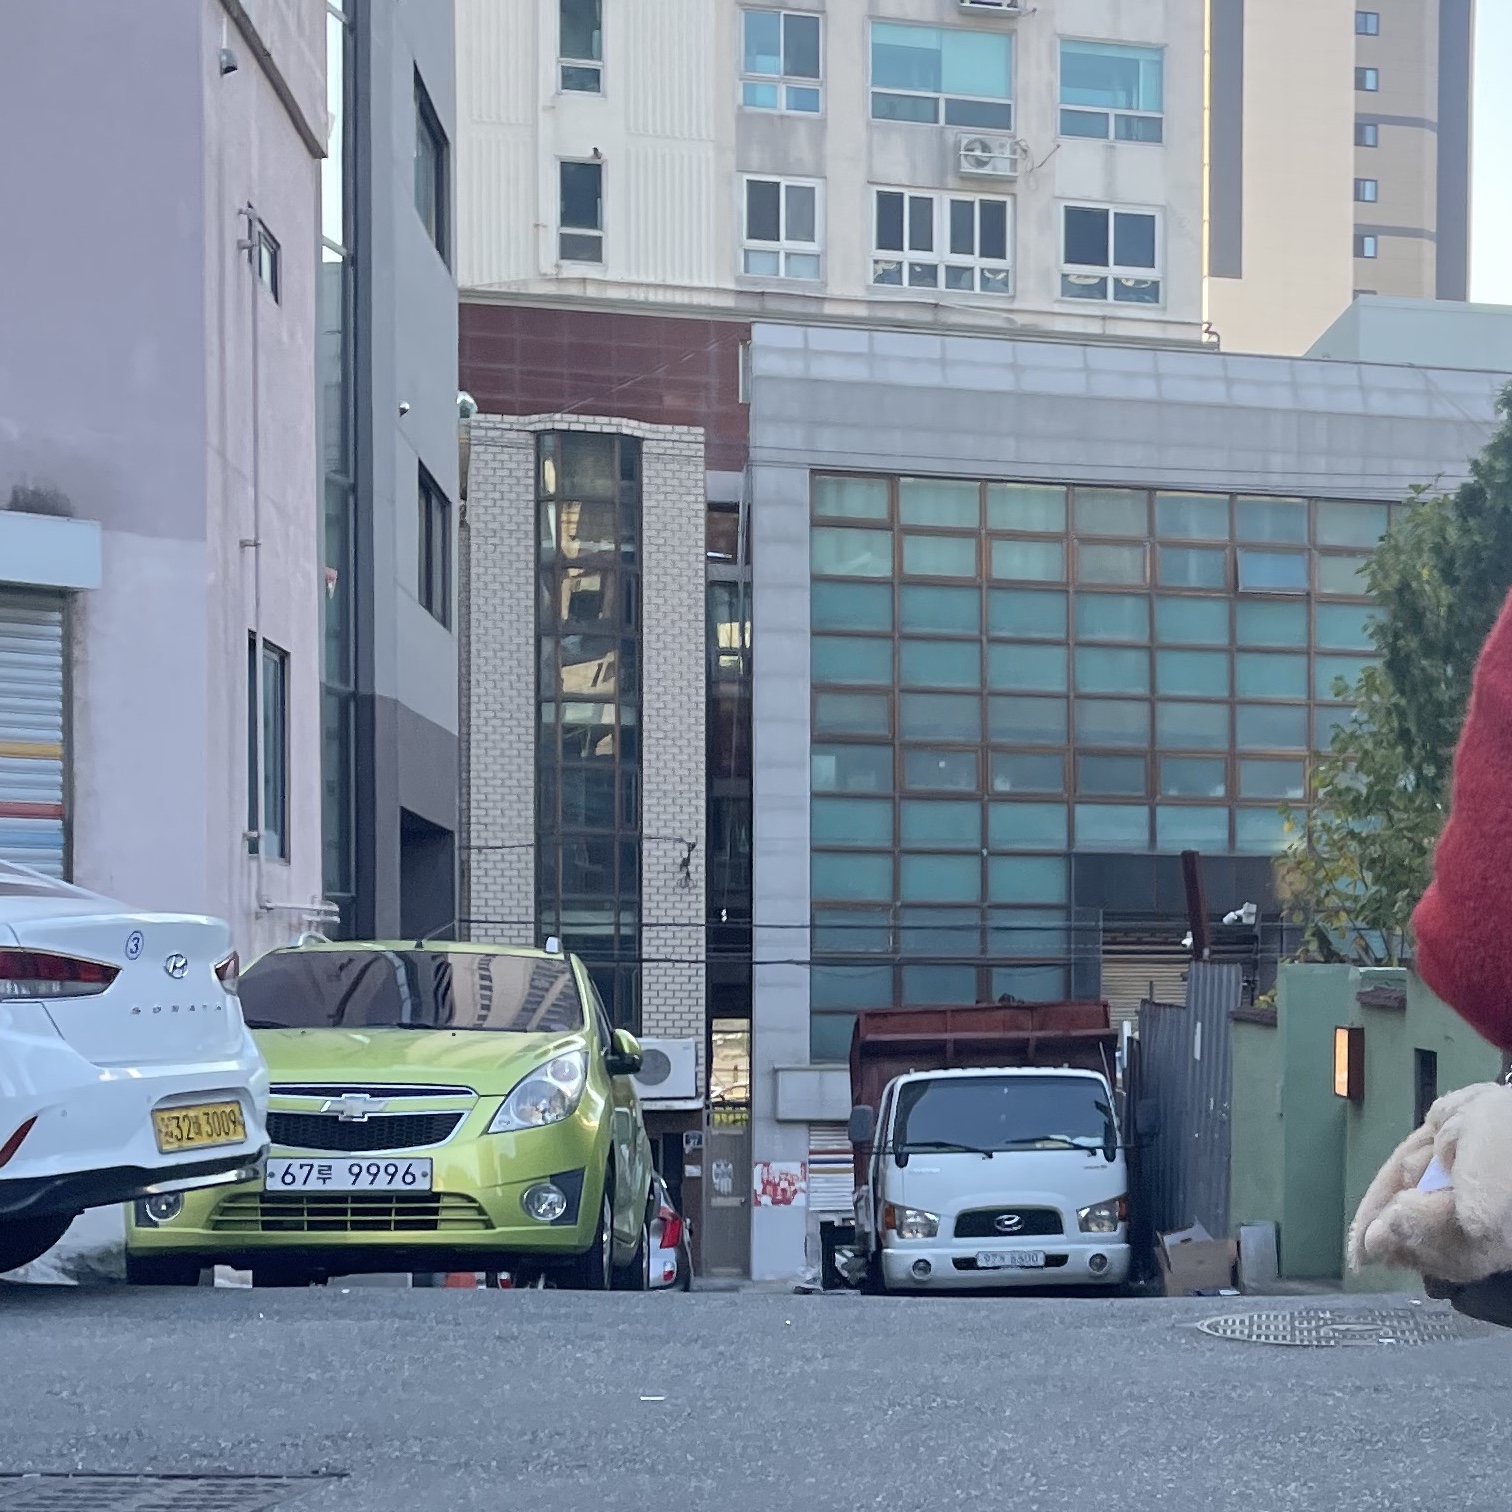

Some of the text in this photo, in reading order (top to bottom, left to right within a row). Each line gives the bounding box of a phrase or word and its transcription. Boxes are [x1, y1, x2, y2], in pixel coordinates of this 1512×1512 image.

[202, 1108, 237, 1138] 3009
[280, 1162, 417, 1186] 67루 9996
